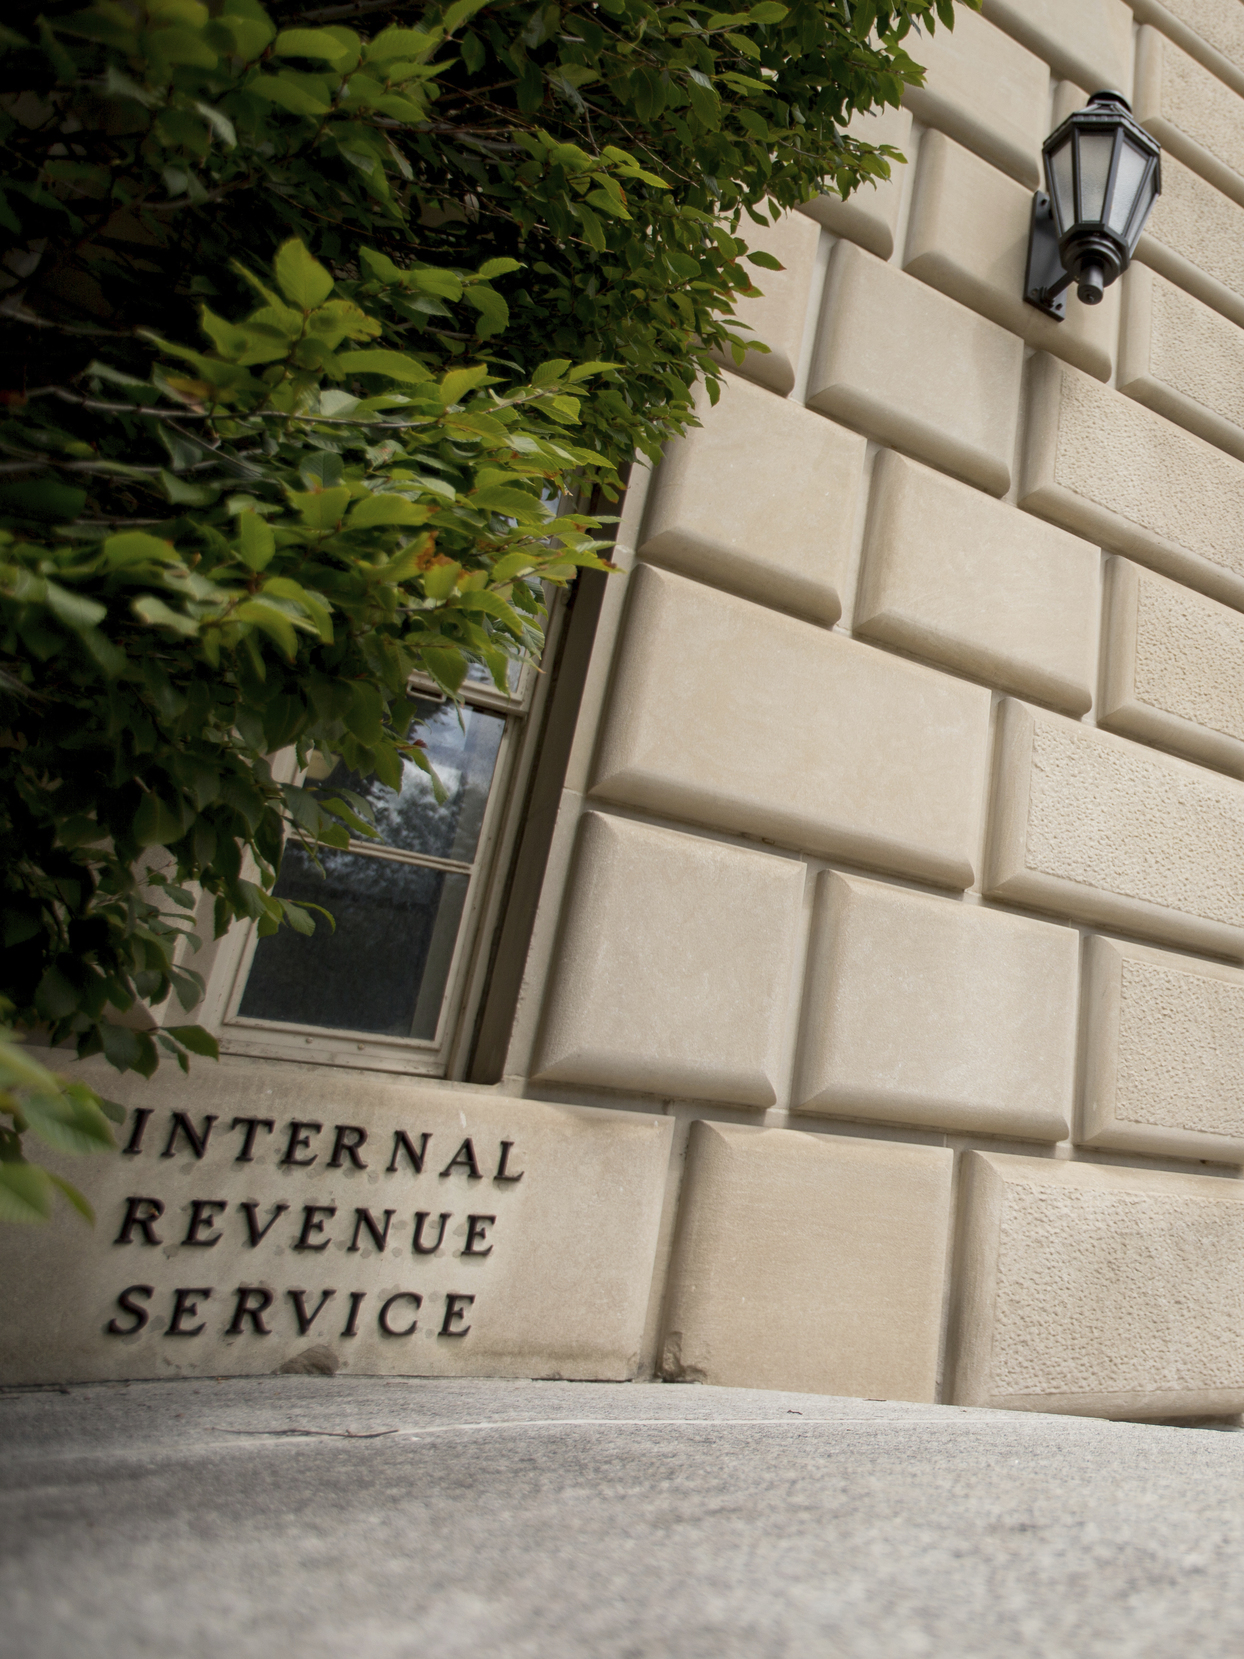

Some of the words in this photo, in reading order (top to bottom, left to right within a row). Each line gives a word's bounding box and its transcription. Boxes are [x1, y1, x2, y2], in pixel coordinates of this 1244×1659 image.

[122, 1106, 526, 1182] INTERNAL
[113, 1196, 497, 1257] REVENUE
[106, 1284, 477, 1338] SERVICE
